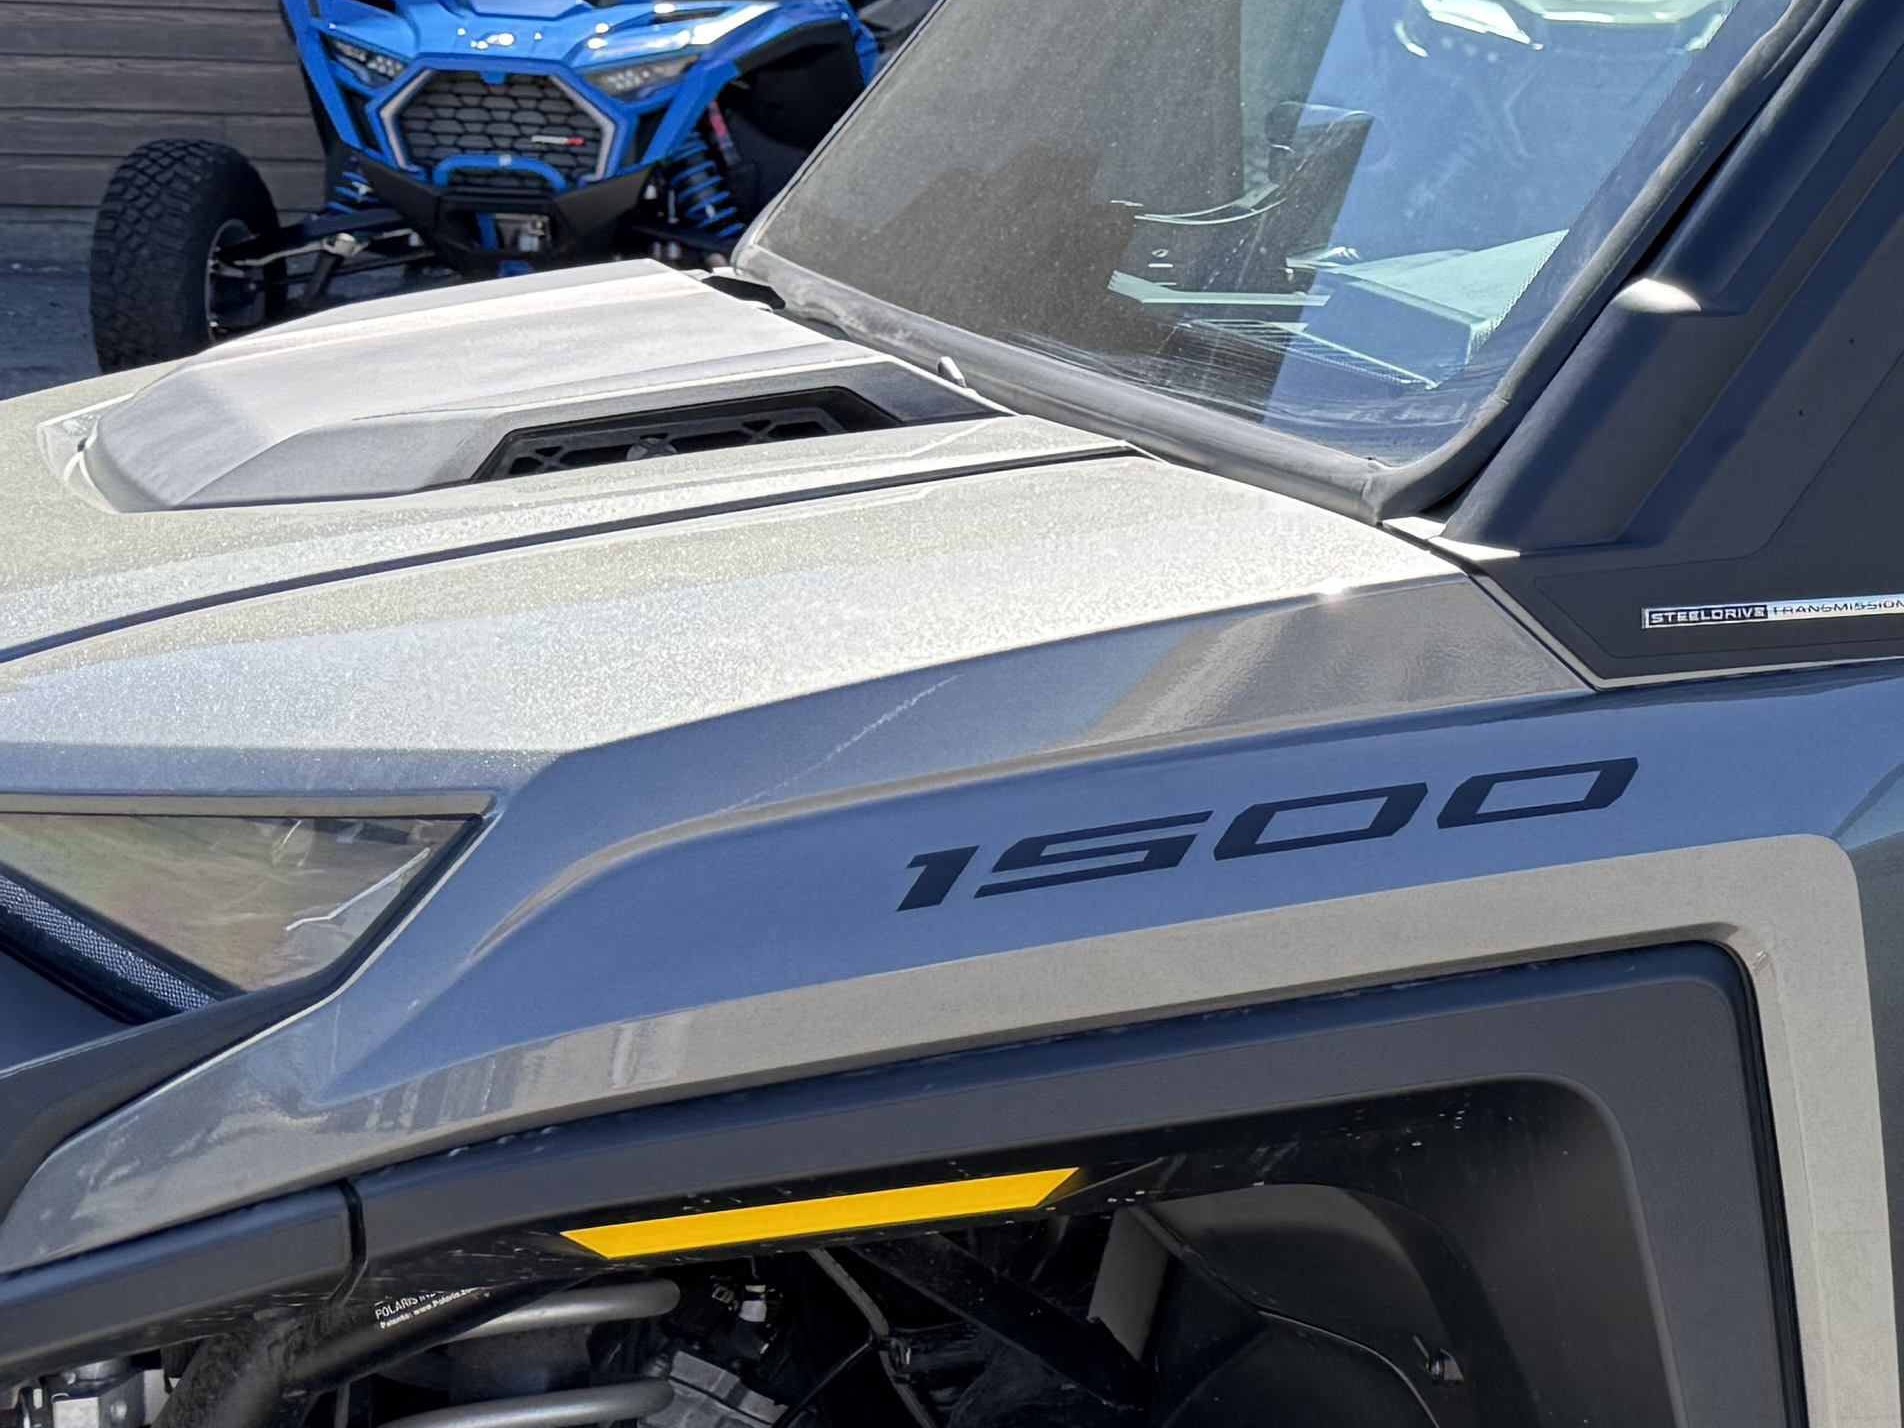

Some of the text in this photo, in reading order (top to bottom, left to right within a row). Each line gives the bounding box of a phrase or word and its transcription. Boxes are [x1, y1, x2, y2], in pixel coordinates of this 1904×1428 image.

[1649, 605, 1766, 626] STEELDRIVE
[896, 757, 1639, 912] 1500
[374, 1297, 418, 1320] POLARIS
